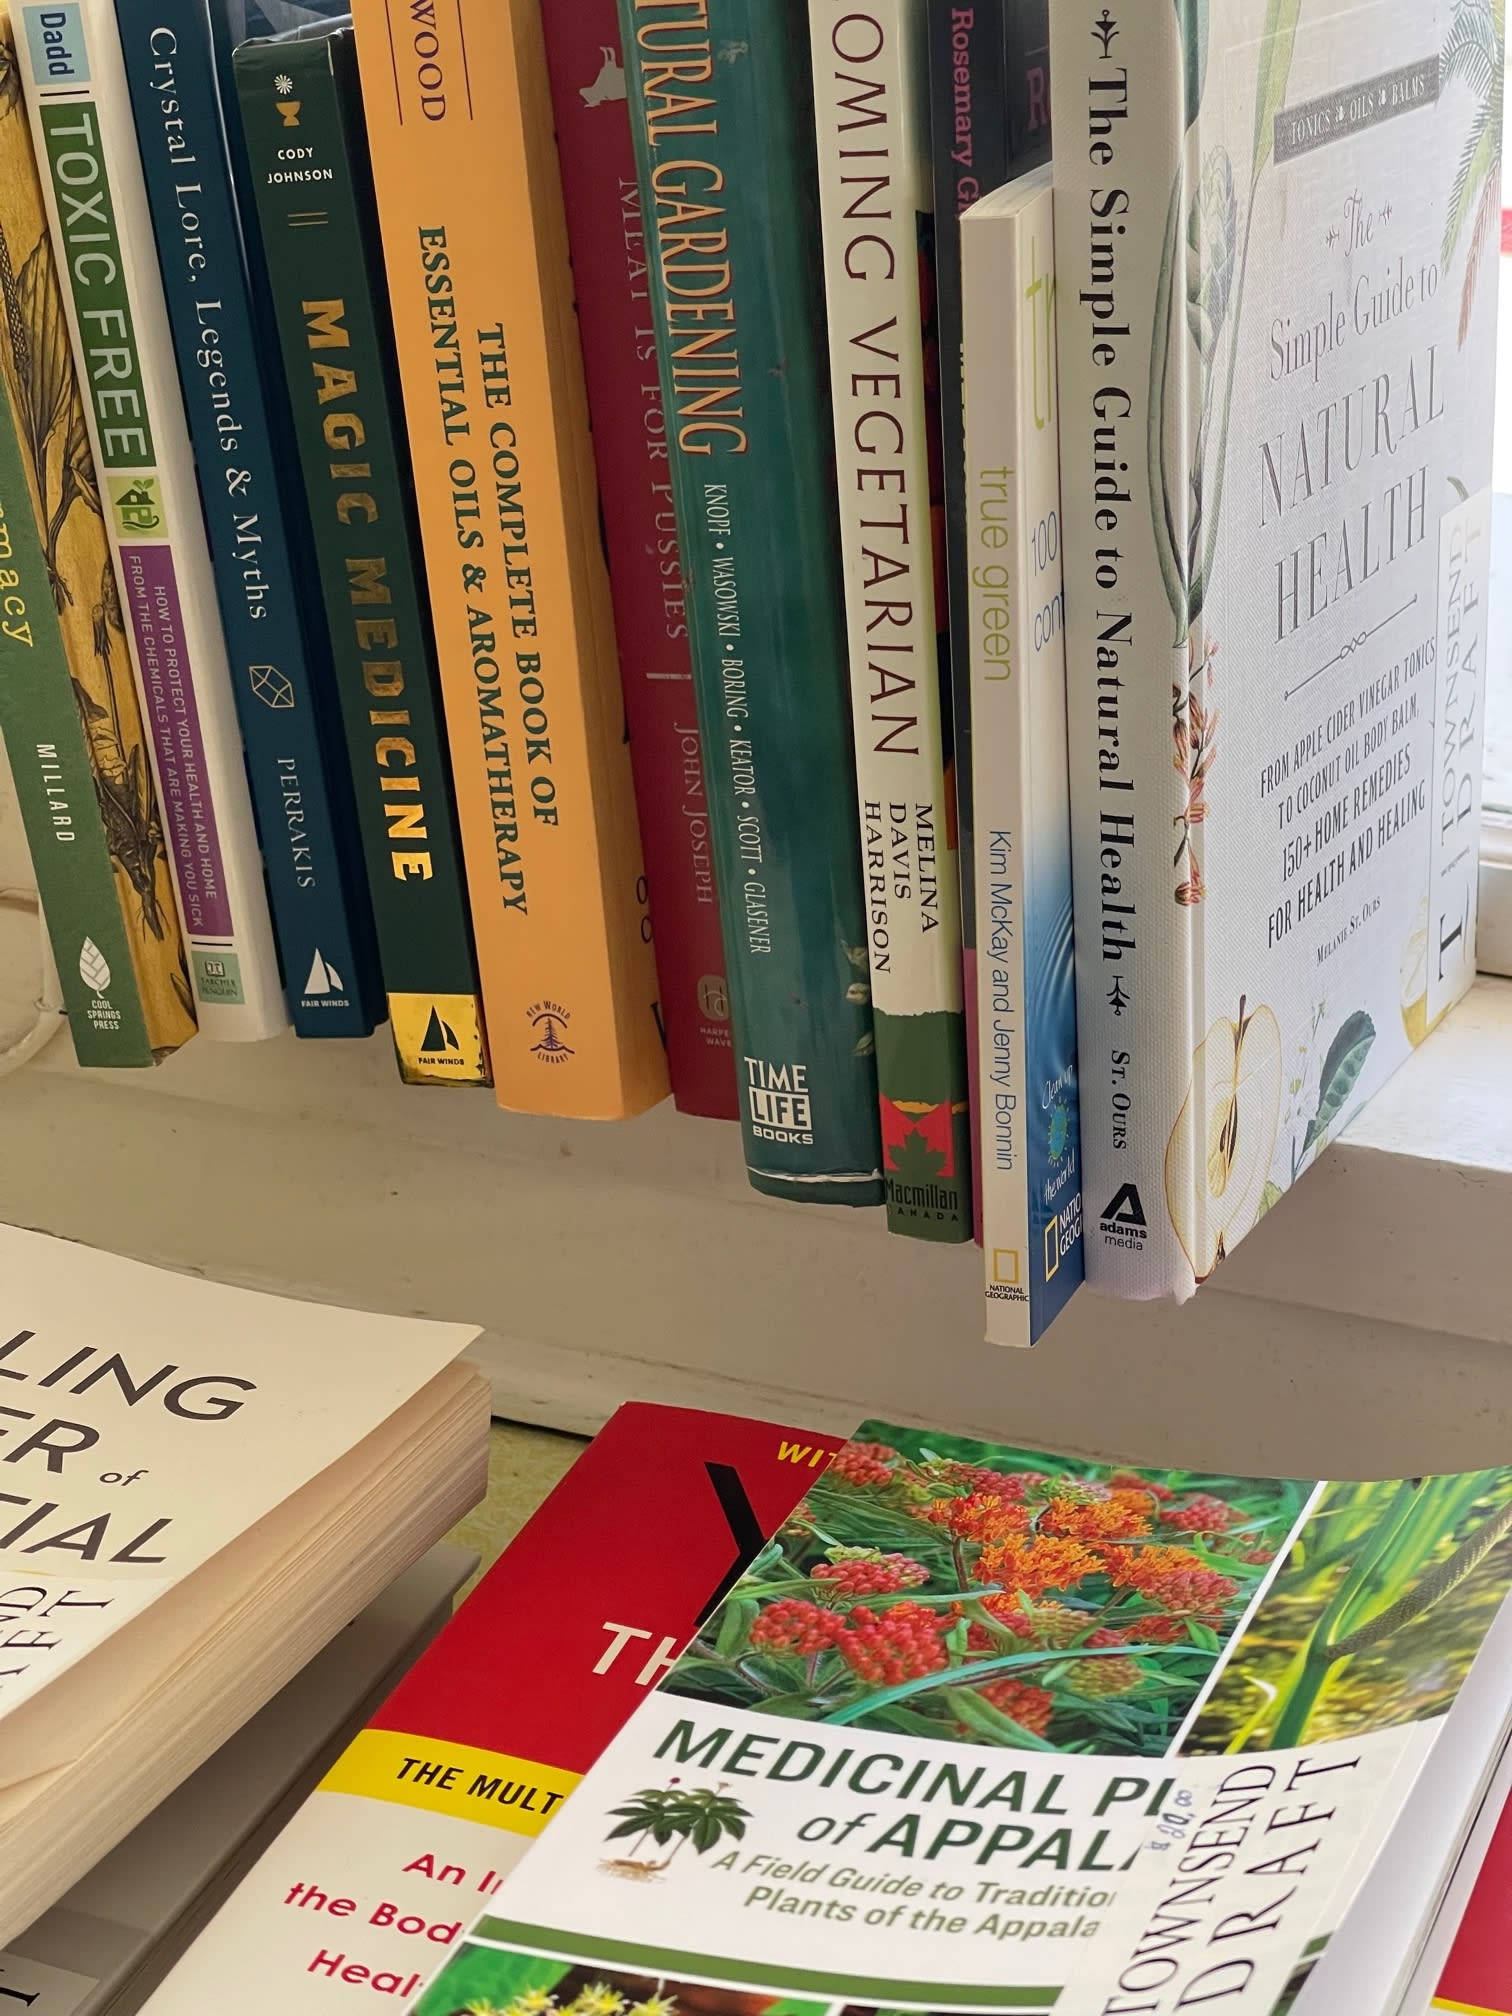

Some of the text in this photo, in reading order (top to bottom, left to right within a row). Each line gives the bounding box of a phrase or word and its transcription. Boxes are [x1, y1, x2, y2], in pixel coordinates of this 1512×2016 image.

[40, 12, 75, 76] Dadd
[951, 8, 975, 168] Rosemary
[277, 148, 314, 160] CODY
[1290, 74, 1425, 145] TONICS OILS BALMS
[267, 169, 333, 184] JOHNSON
[1344, 188, 1374, 257] The
[50, 113, 148, 457] TOXIC FREE
[150, 26, 270, 620] Crystal Lore, Legends & Myths
[651, 160, 748, 456] GARDENING
[1271, 256, 1438, 384] Simple Guide to
[635, 325, 656, 361] IS
[832, 0, 919, 756] OMING VEGETARIAN
[641, 384, 668, 460] FOR
[1258, 345, 1444, 528] NATURAL
[1032, 511, 1057, 576] 100
[1079, 67, 1137, 962] The Simple Guide to Natural Health
[1275, 464, 1428, 643] HEALTH
[302, 299, 433, 882] MAGIC MEDICINE
[418, 225, 528, 916] ESSENTIAL OILS & AROMATHERAPY
[477, 322, 559, 827] THE COMPLETE BOOK OF
[972, 466, 1014, 681] true green
[1034, 591, 1064, 652] con
[704, 483, 771, 954] KNOPF WASOWSKI BORING KEATOR SCOTT GLASENER
[1441, 525, 1462, 846] TOWNSEND
[1457, 517, 1480, 824] DRAFT
[129, 555, 204, 928] FROM THE CHEMICALS THAT ARE MAKING YOU SICK
[153, 586, 217, 899] HOW TO PROTECT YOUR HEALTH AND HOME
[1260, 752, 1289, 798] FROM
[1294, 725, 1323, 770] APPLE
[1326, 701, 1355, 742] CIDER
[1359, 665, 1399, 716] VINEGAR
[1278, 795, 1293, 830] TO
[1297, 756, 1342, 815] COCONUT
[1345, 748, 1360, 775] OIL
[1364, 720, 1389, 766] BODY
[36, 744, 75, 842] MILLARD
[278, 758, 315, 888] PERRAKIS
[674, 723, 712, 904] JOHN JOSEPH
[1283, 743, 1412, 881] 150+ HOME REMEDIES
[864, 800, 892, 975] HARRISON
[889, 802, 912, 900] DAVIS
[915, 803, 940, 933] MELINA
[1268, 780, 1426, 948] FOR HEALTH AND HEALING
[87, 1010, 121, 1020] SPRINGS
[91, 1000, 113, 1009] COOL
[93, 1020, 120, 1030] PRESS
[987, 831, 1016, 1171] Kim McKay and Jenny Bonnin
[418, 1057, 465, 1066] FAIR WINDS
[744, 1056, 808, 1092] TIME
[752, 1091, 807, 1126] LIFE
[753, 1124, 813, 1145] BOOKS
[886, 1178, 958, 1210] Macmillan
[889, 1206, 959, 1222] ANADA
[1100, 1222, 1147, 1239] adams
[989, 1284, 1024, 1294] NATIONAL
[1104, 1235, 1143, 1251] media
[985, 1290, 1029, 1302] GEOGRAPHIC
[100, 1469, 149, 1487] of
[397, 1758, 564, 1815] THE MULT
[653, 1719, 1068, 1815] MEDICINAL
[402, 1854, 466, 1886] An
[712, 1851, 739, 1871] A
[742, 1855, 827, 1883] Field
[828, 1867, 923, 1898] Guide
[929, 1882, 964, 1901] to
[797, 1813, 876, 1846] of
[866, 1814, 1143, 1871] APPAL
[1102, 1765, 1276, 2016] TOWNSEND
[1174, 1756, 1361, 2013] DRAFT
[283, 1882, 465, 1944] the Bod
[744, 1886, 1103, 1941] Plants of the Appala
[307, 1949, 424, 1998] Heal
